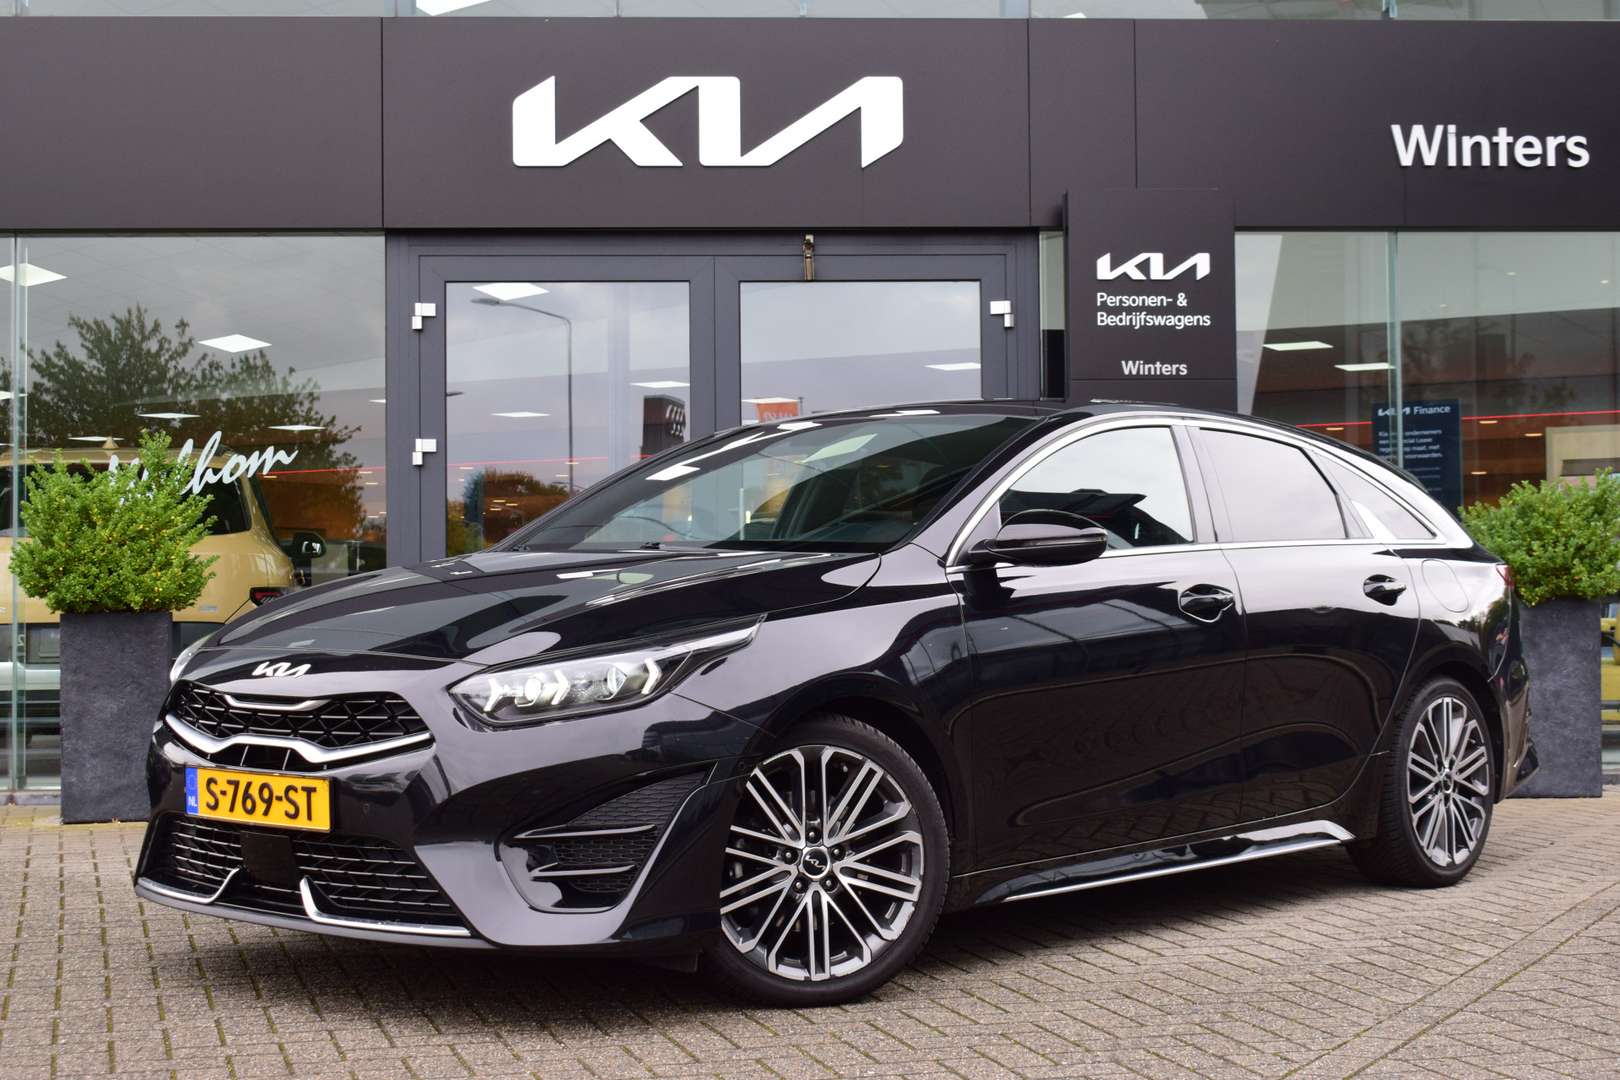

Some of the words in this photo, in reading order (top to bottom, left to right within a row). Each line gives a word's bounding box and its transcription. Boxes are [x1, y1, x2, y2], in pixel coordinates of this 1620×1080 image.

[513, 75, 904, 168] KIA
[1390, 124, 1591, 168] Winters
[1096, 252, 1211, 281] KIA
[1096, 292, 1173, 307] Personen-
[1176, 292, 1188, 307] &
[1096, 312, 1212, 330] Bedrijfswagens
[1121, 360, 1188, 375] Winters
[1413, 405, 1451, 415] Finance
[188, 796, 198, 807] NL
[205, 776, 317, 822] S-769-ST
